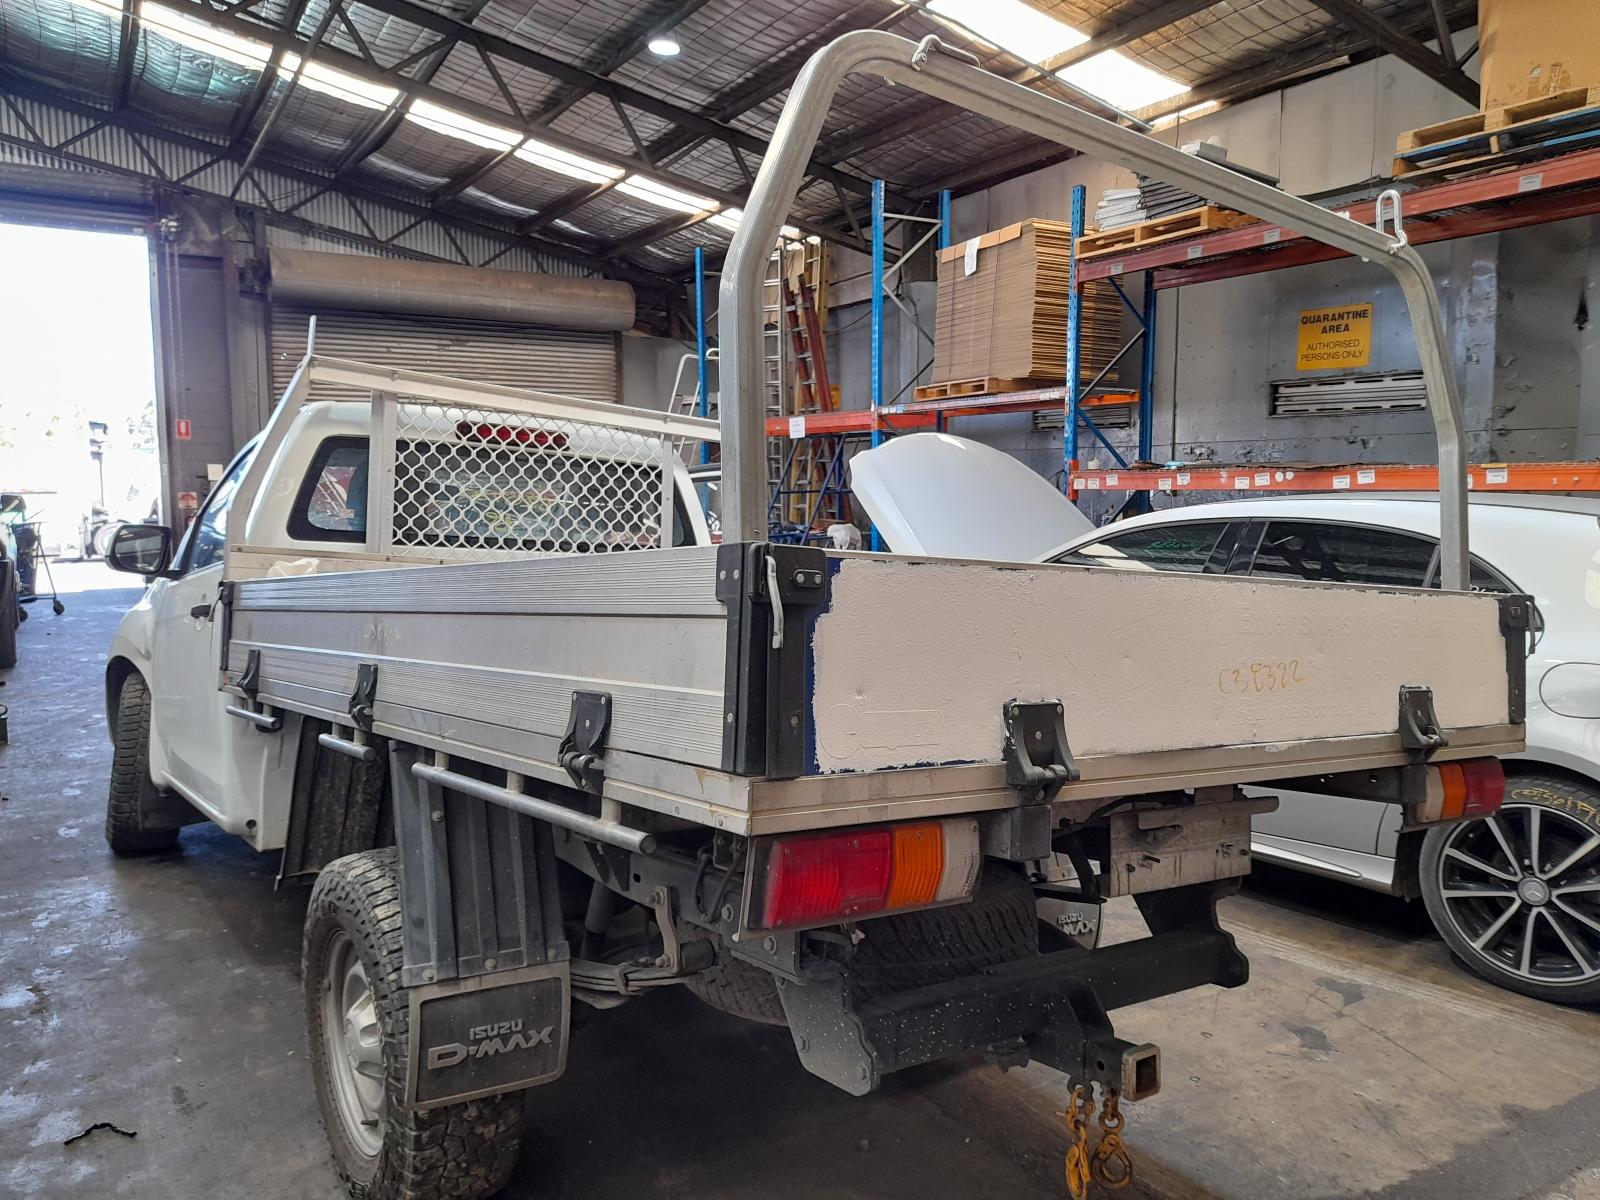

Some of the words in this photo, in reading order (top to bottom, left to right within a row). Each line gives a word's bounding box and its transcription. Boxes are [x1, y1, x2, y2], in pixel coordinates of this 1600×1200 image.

[1301, 309, 1368, 324] QUARANTINE
[1321, 324, 1349, 334] AREA
[1306, 339, 1359, 351] AUTHORISED
[1300, 351, 1340, 362] PERSONS
[1342, 350, 1363, 359] ONLY
[1056, 913, 1083, 924] ISUZU
[469, 1018, 523, 1040] ISUZU
